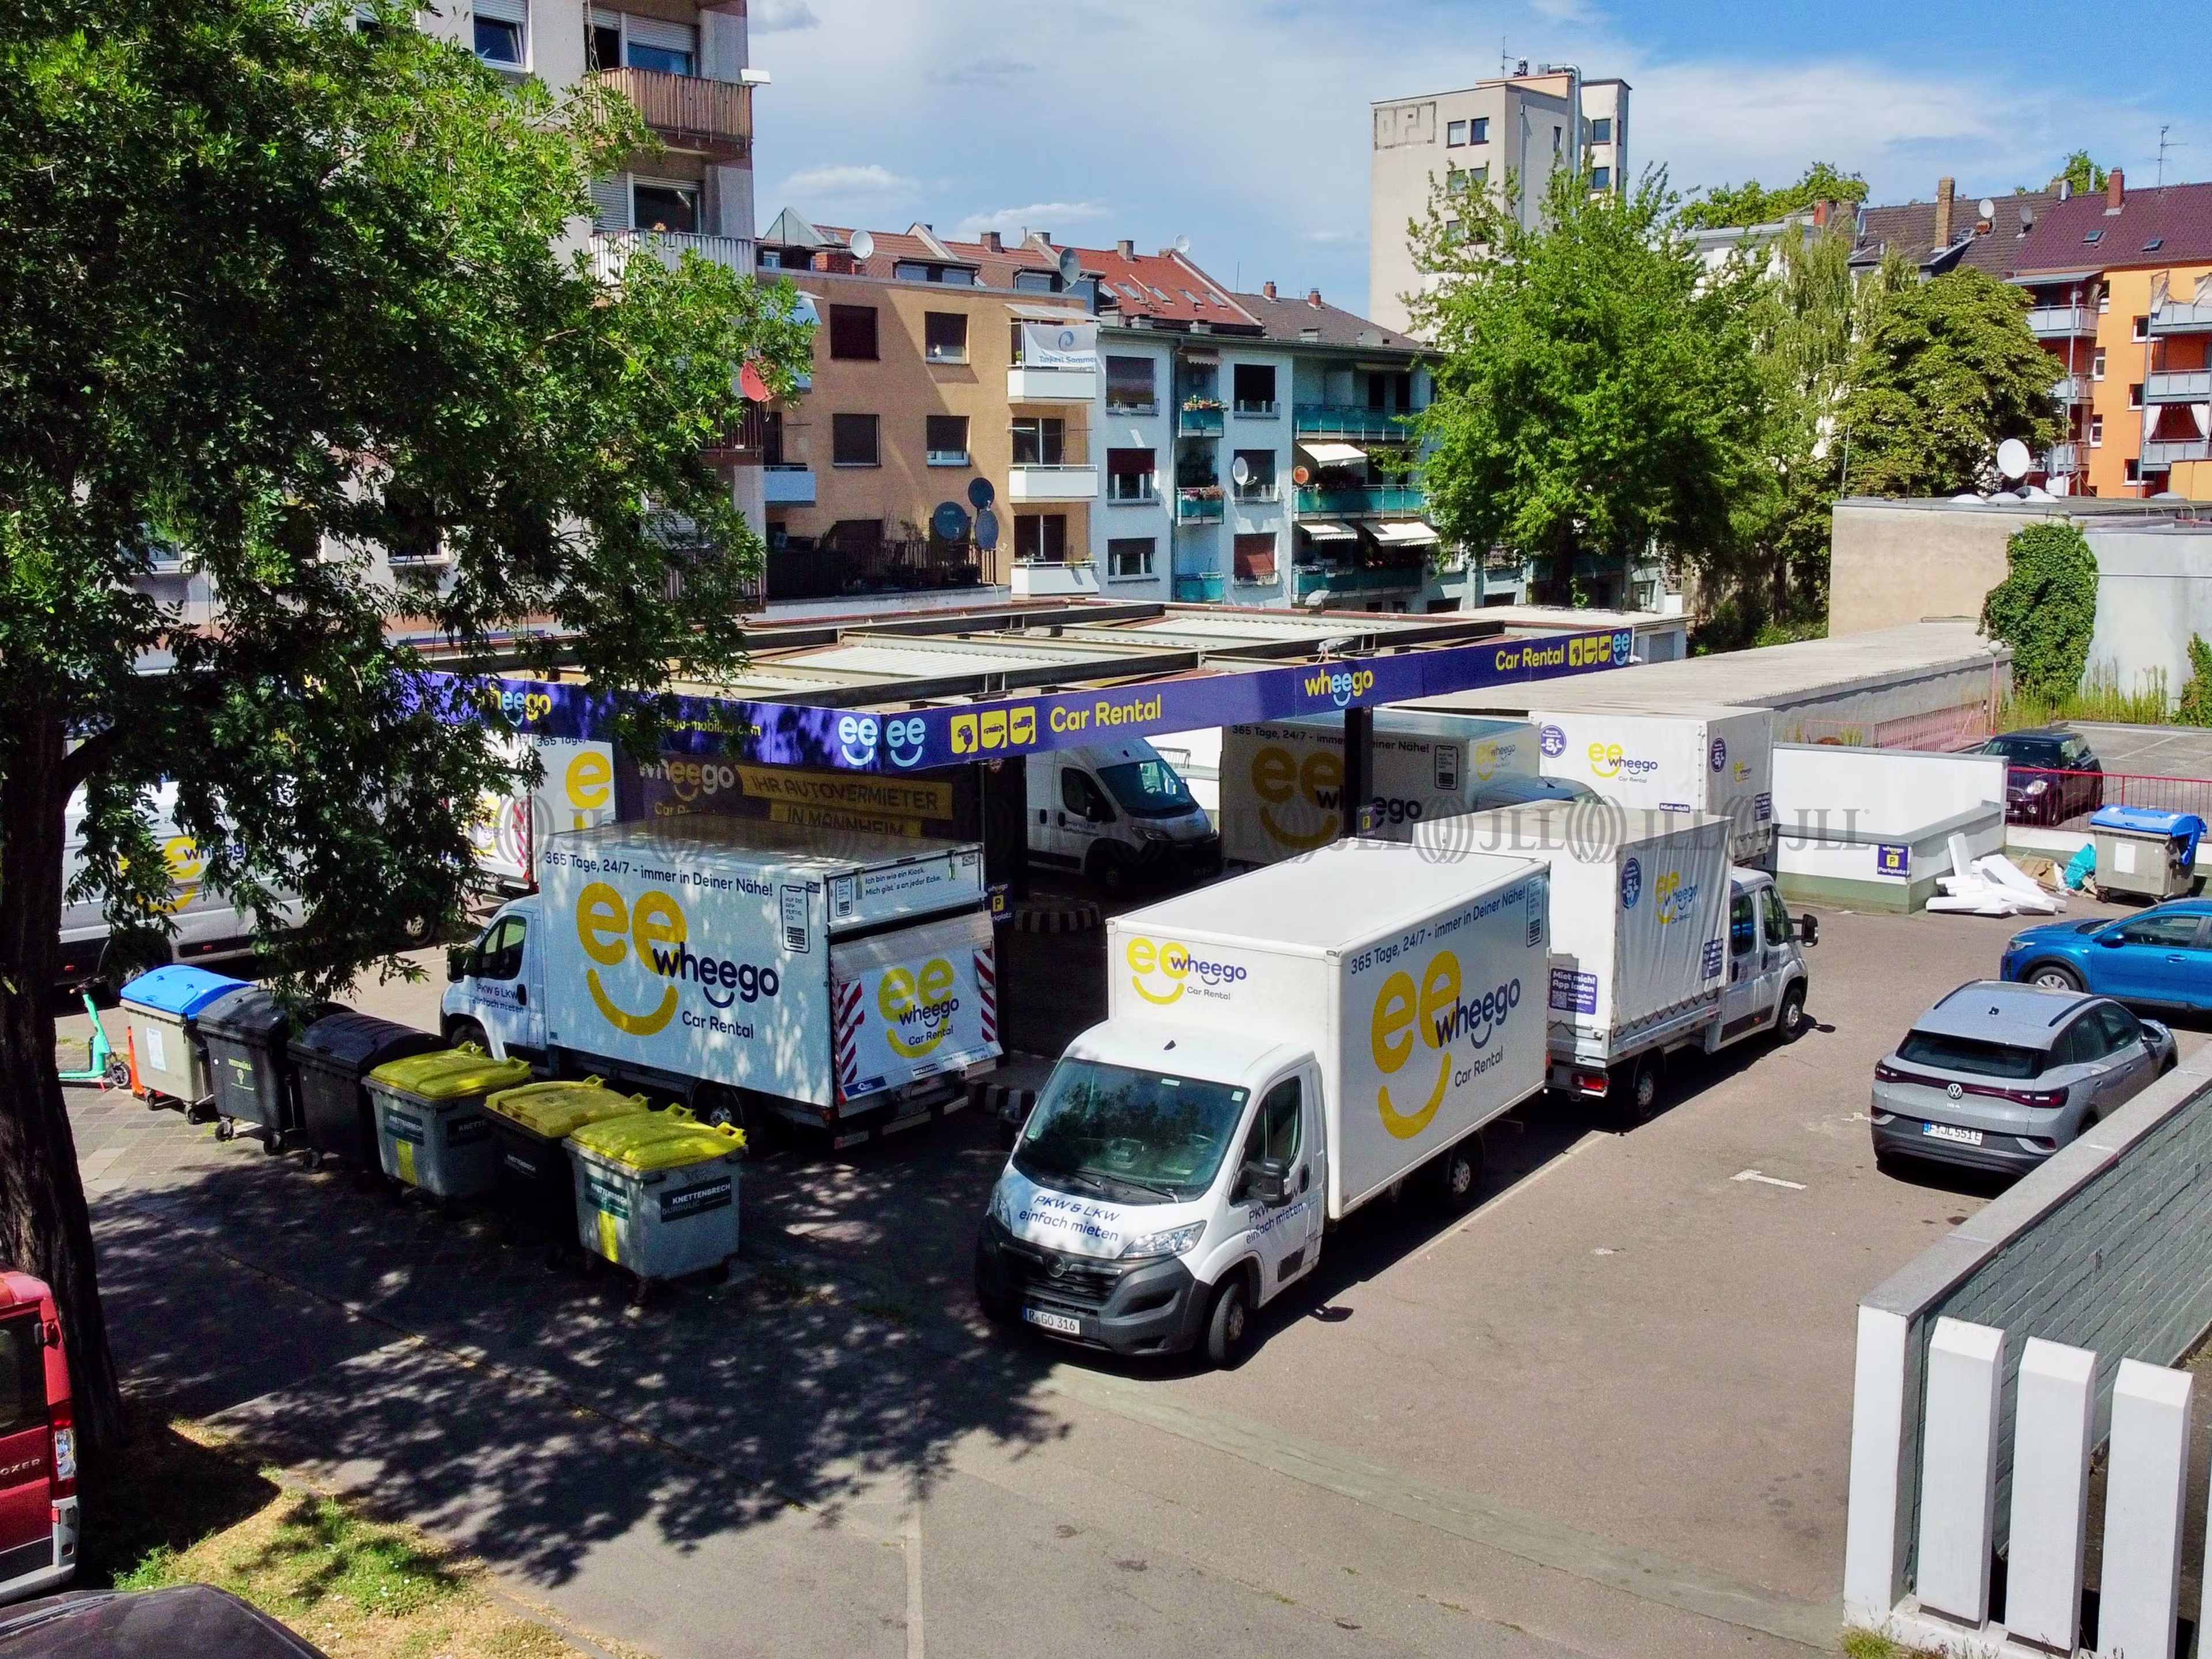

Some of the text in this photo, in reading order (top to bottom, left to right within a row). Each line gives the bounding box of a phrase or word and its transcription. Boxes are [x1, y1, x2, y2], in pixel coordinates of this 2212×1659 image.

[1496, 649, 1521, 672] Car
[1524, 644, 1564, 668] Rental
[1304, 668, 1374, 698] wheego
[1050, 694, 1161, 733] Car Rental
[1232, 725, 1252, 735] 365
[1255, 727, 1280, 739] Tage,
[1283, 729, 1306, 740] 24/7
[1372, 740, 1394, 751] einer
[1398, 739, 1430, 753] Nähe!
[1608, 756, 1658, 772] wheego
[751, 775, 938, 810] IHR AUTOVERMIETER
[787, 805, 904, 835] IN MANNHEIM
[546, 851, 567, 865] 365
[570, 854, 600, 873] Tage,
[603, 859, 630, 874] 24/7
[640, 868, 677, 882] immer
[679, 873, 690, 885] in
[694, 872, 732, 890] Deiner
[736, 877, 773, 897] Nähe!
[1889, 857, 1896, 865] P
[865, 877, 875, 885] Ich
[876, 874, 885, 883] bin
[897, 870, 907, 878] ein
[865, 887, 881, 896] Mich
[995, 897, 1001, 909] P
[1351, 955, 1372, 975] 365
[1374, 945, 1400, 965] Tage,
[1403, 928, 1426, 952] 24/7
[1434, 916, 1462, 940] immer
[1463, 910, 1472, 926] in
[1473, 899, 1500, 921] Deiner
[1502, 884, 1525, 908] Nähe!
[653, 941, 779, 1003] wheego
[1171, 953, 1247, 983] wheego
[1553, 971, 1595, 984] Miet mich!
[476, 983, 493, 995] PKW
[1186, 986, 1231, 1001] Car Rental
[1552, 979, 1594, 993] App laden
[682, 1010, 754, 1039] Car Rental
[899, 997, 959, 1027] wheego
[1435, 978, 1521, 1048] wheego
[908, 1025, 954, 1046] Car Rental
[1455, 1047, 1504, 1088] Car Rental
[672, 1183, 731, 1205] KNETTENBRECH
[1033, 1195, 1120, 1222] PKW & LKW
[1019, 1209, 1119, 1242] einfach mieten
[1246, 1203, 1304, 1244] einfach mieten
[1028, 1310, 1075, 1331] R GO 316
